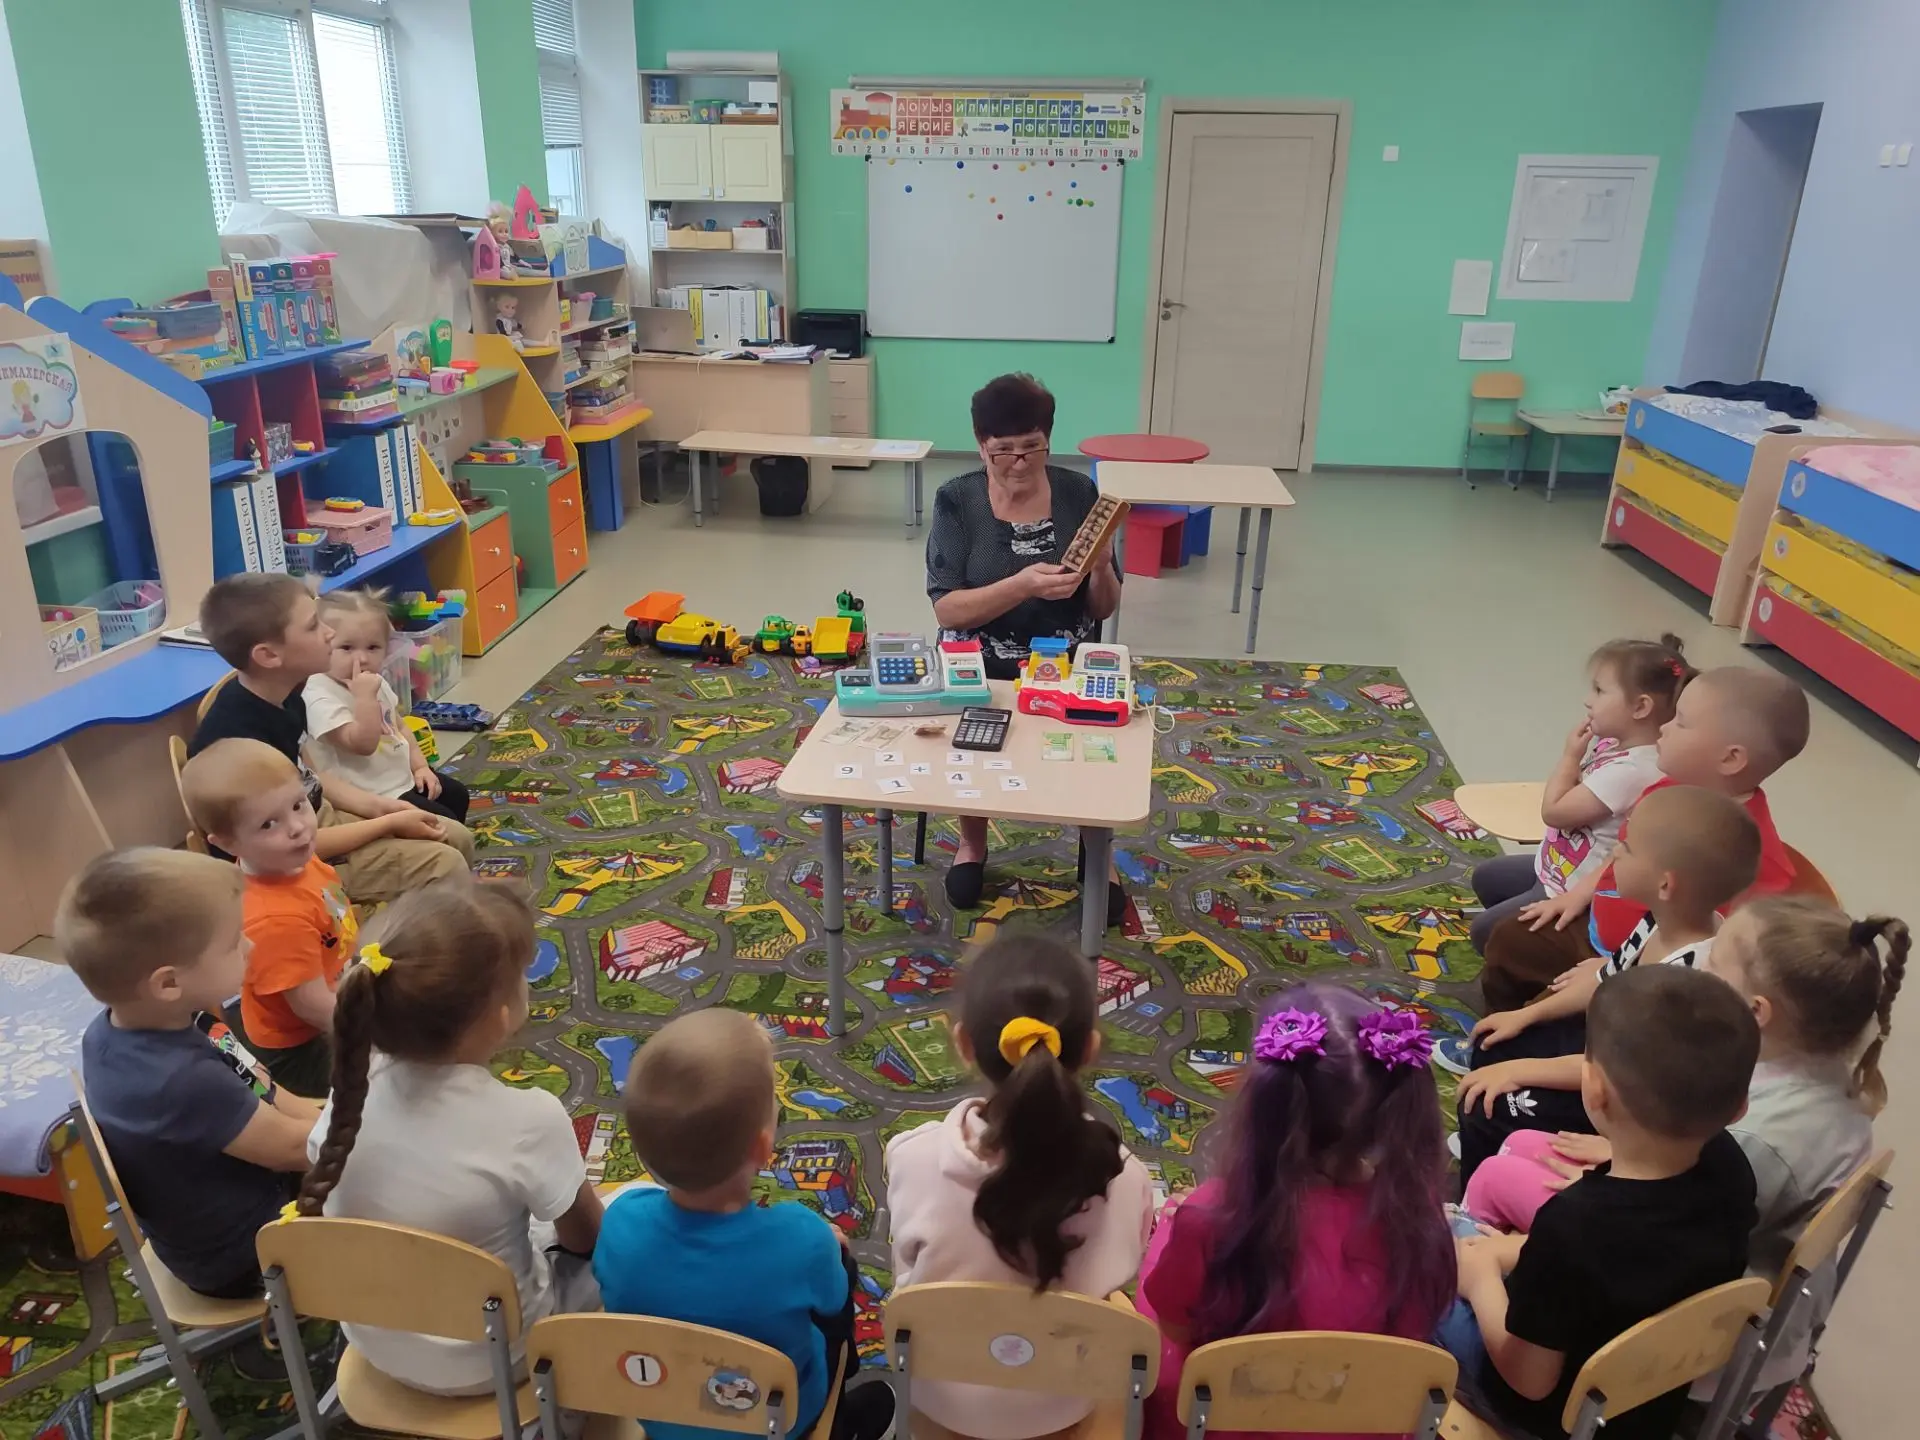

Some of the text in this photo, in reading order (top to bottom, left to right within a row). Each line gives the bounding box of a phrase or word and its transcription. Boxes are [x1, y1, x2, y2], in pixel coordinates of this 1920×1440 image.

[0, 366, 73, 393] КМАХЕРСКАЯ
[267, 486, 284, 567] Рассказы
[883, 754, 895, 762] 2
[952, 754, 963, 762] 3
[841, 766, 854, 774] 9
[952, 773, 964, 781] 4
[891, 780, 906, 788] 1
[1008, 779, 1021, 787] 5
